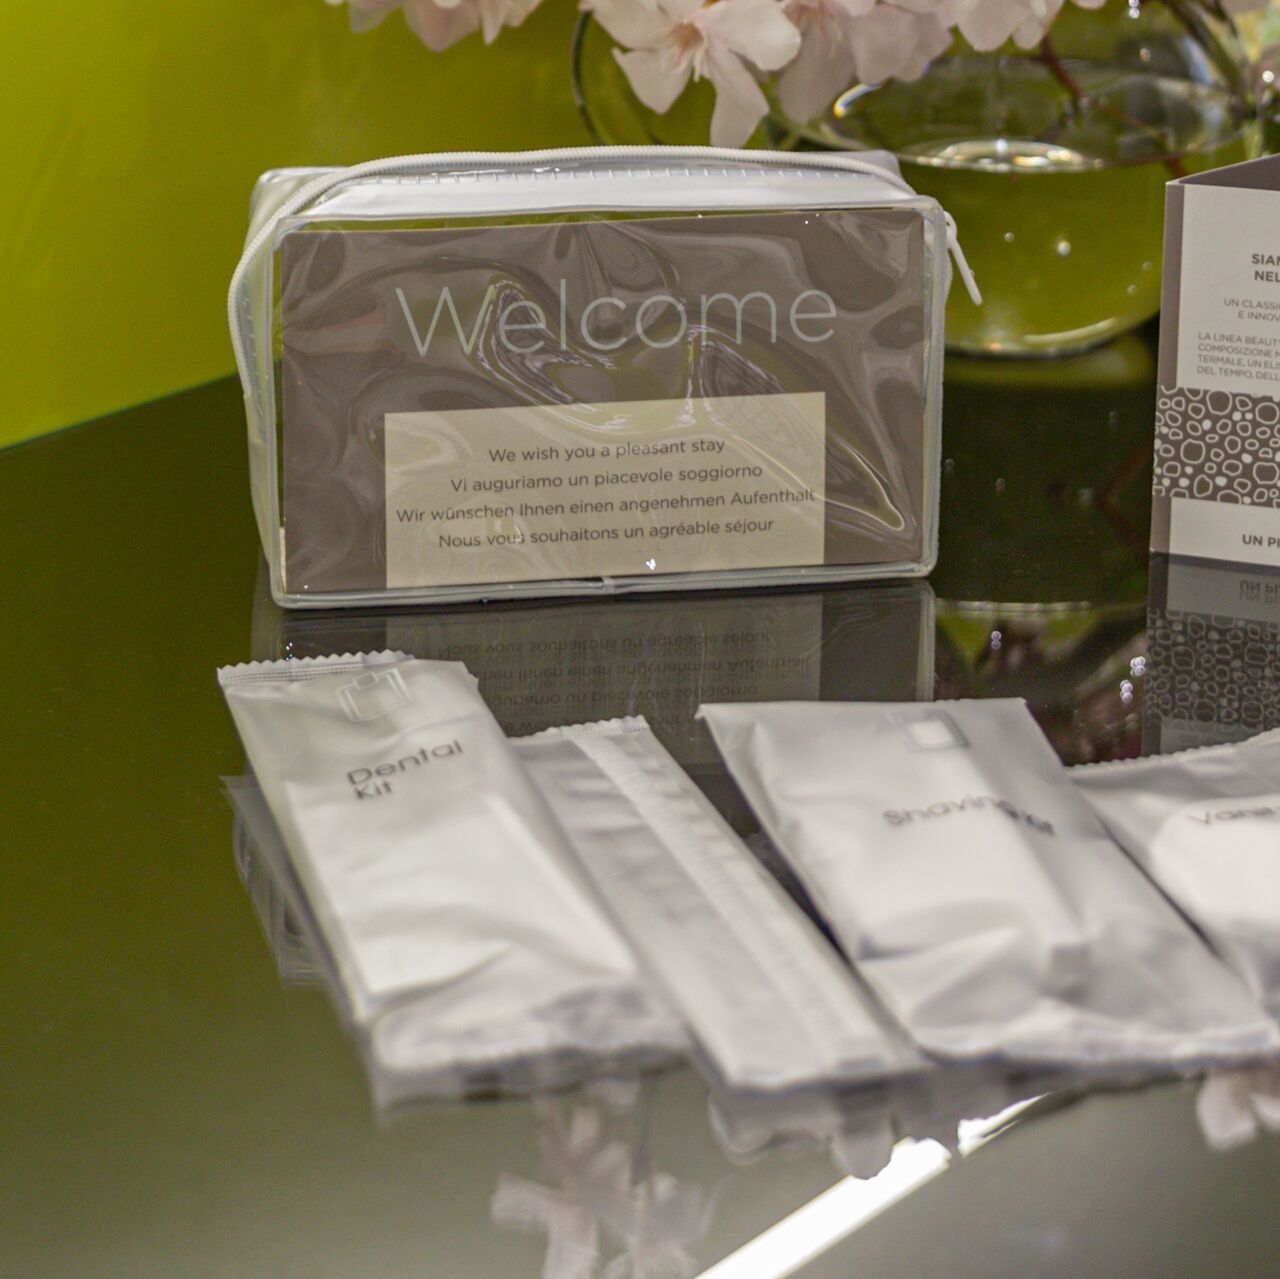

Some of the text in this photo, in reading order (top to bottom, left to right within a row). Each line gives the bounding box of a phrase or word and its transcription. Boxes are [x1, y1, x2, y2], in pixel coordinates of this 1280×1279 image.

[1223, 298, 1239, 307] UN
[395, 278, 838, 358] Welcome
[1238, 310, 1245, 319] E
[1198, 332, 1211, 340] LA
[1214, 333, 1242, 342] LINEA
[1198, 343, 1272, 358] COMPOSIZIONE
[1196, 366, 1216, 376] DEL
[1248, 360, 1261, 368] UN
[488, 438, 725, 462] We wish you a pleasant stay
[451, 464, 762, 493] Vi auguriamo un piacevole soggiorno
[396, 488, 816, 522] Wir wünschen Ihnen einen angenehmen Aufenthalt
[439, 518, 774, 548] Nous vous souhaitons un agréable séjour
[1242, 534, 1263, 546] UN
[346, 739, 464, 785] Dental
[354, 780, 392, 800] Kit
